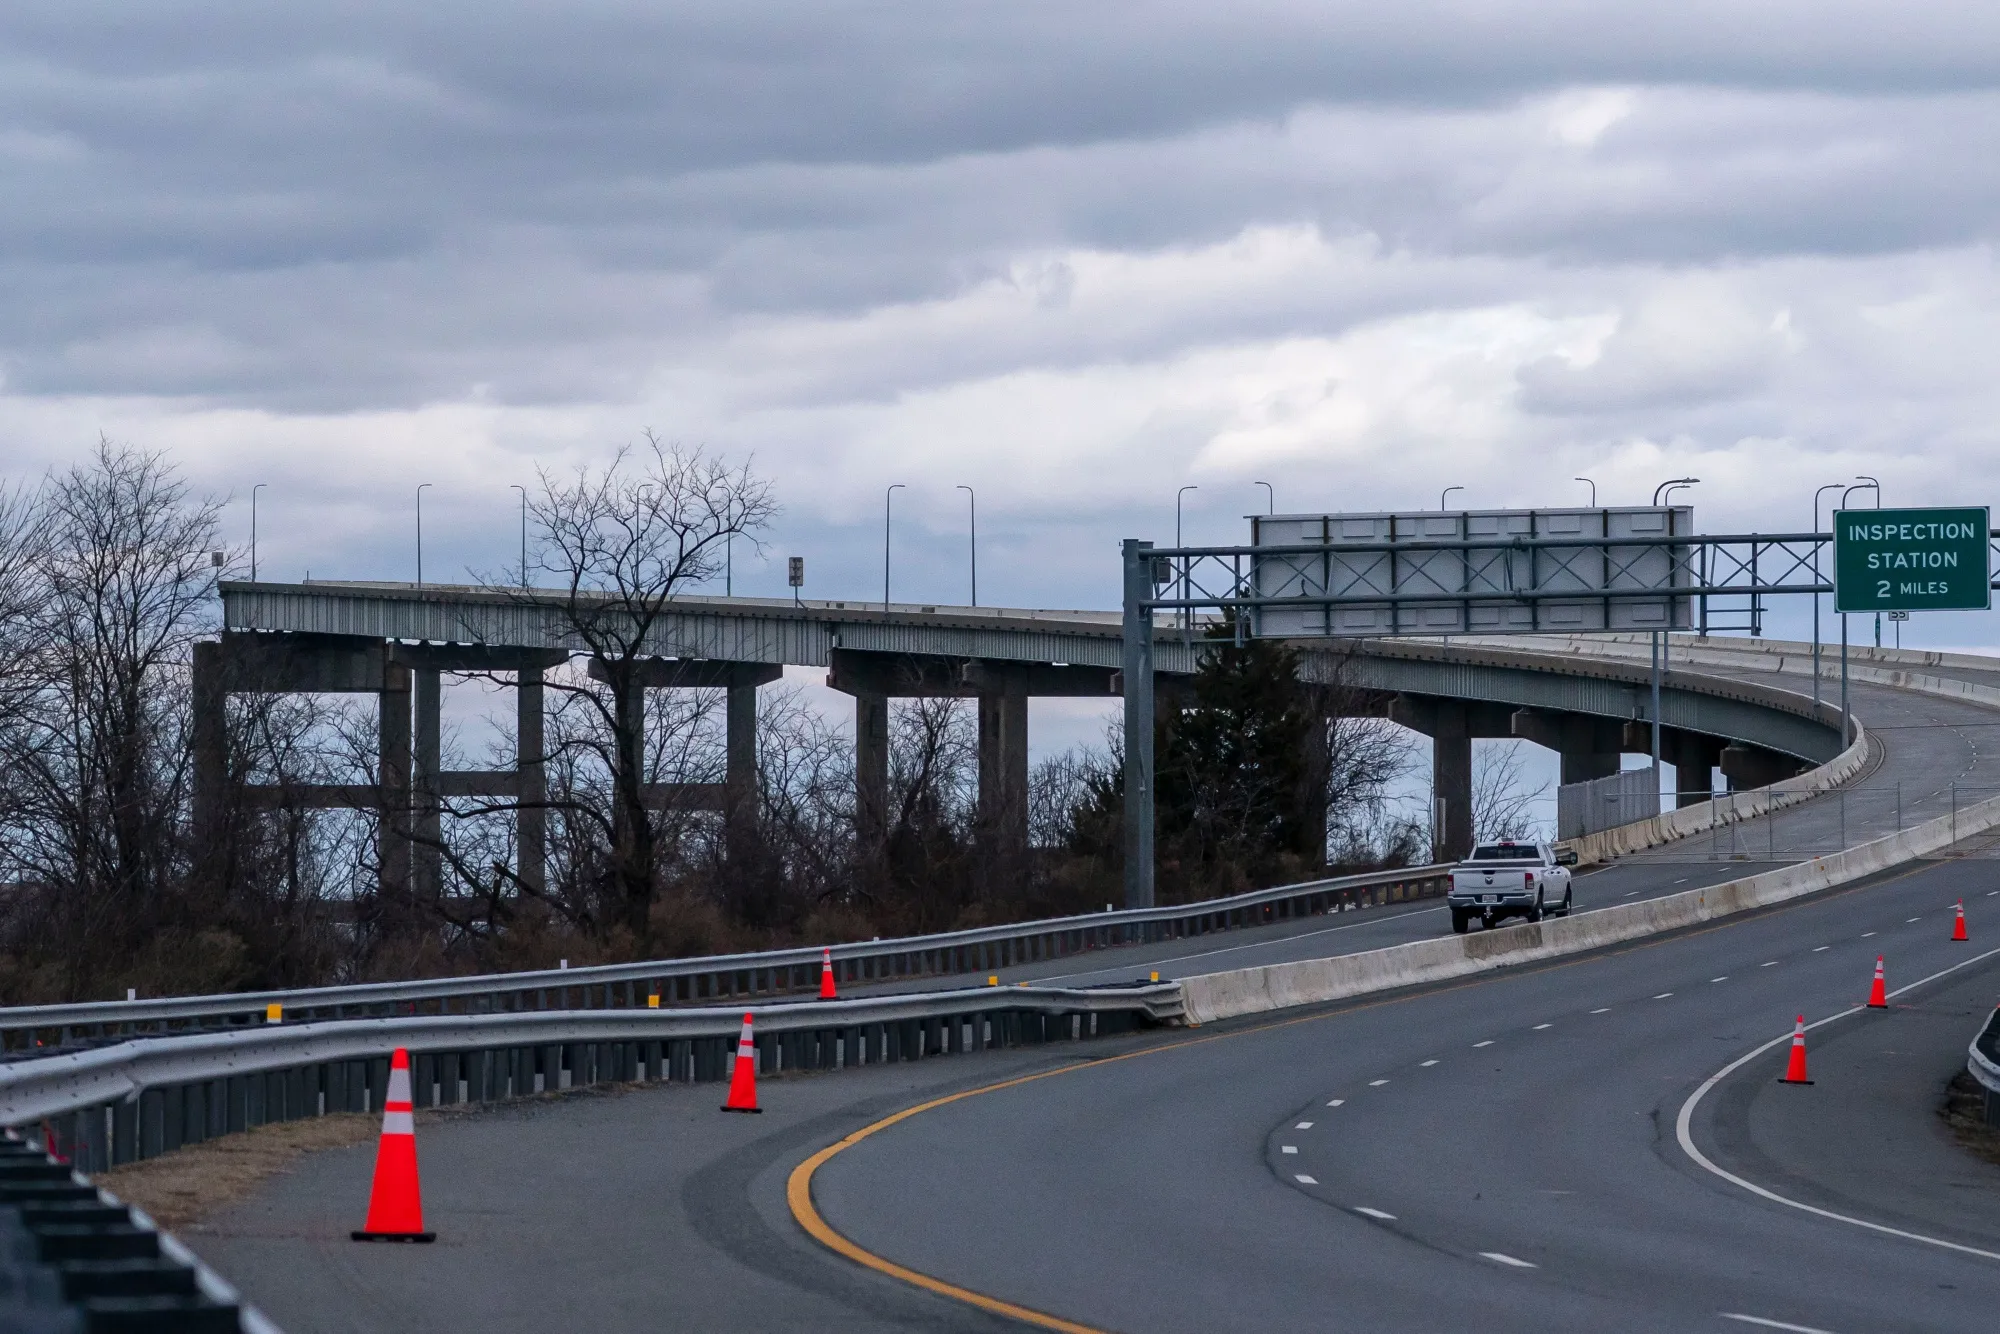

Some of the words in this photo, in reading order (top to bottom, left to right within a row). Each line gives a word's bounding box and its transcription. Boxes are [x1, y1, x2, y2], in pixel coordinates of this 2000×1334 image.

[1849, 523, 1975, 541] INSPECTION
[1867, 552, 1957, 569] STATION
[1877, 580, 1891, 598] 2
[1900, 581, 1948, 595] MILES
